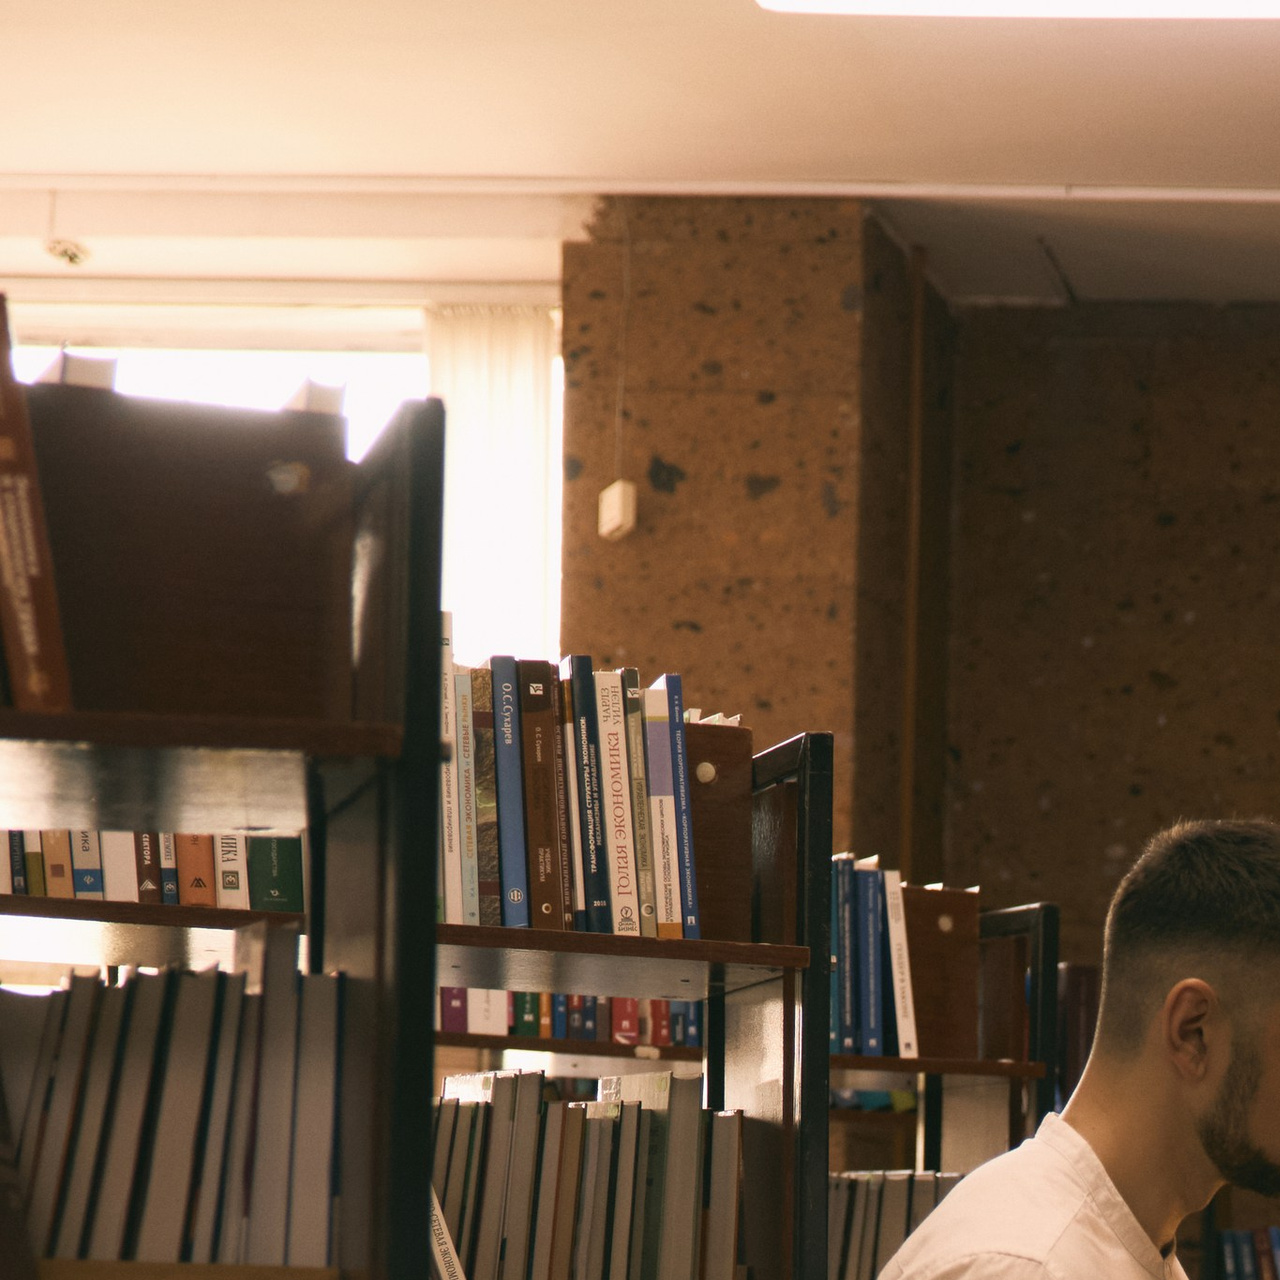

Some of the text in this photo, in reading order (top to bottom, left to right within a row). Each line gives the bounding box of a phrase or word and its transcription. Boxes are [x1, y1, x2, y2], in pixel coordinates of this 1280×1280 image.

[461, 694, 470, 723] РЫНКИ
[601, 687, 611, 723] ЧАРЛЗ
[610, 685, 622, 726] УИЛЭН
[462, 724, 472, 759] СЕТЕВЫЕ
[588, 744, 599, 792] УПРАВЛЕНИЕ
[677, 754, 686, 811] КОРПОРАТИВИЗМА.
[463, 768, 473, 824] ЭКОНОМИКА
[580, 716, 598, 874] ТРАНСФОРМАЦИЯ СТРУКТУРЫ ЭКОНОМИКИ:
[636, 781, 646, 830] УПРАВЛЕНЧЕСКАЯ
[142, 832, 151, 866] СЕКТОРА
[464, 824, 474, 859] СЕТЕВАЯ
[639, 833, 648, 867] ЭКОНОМИКА
[561, 843, 571, 905] ПРОЕКТИРОВАНИЯ
